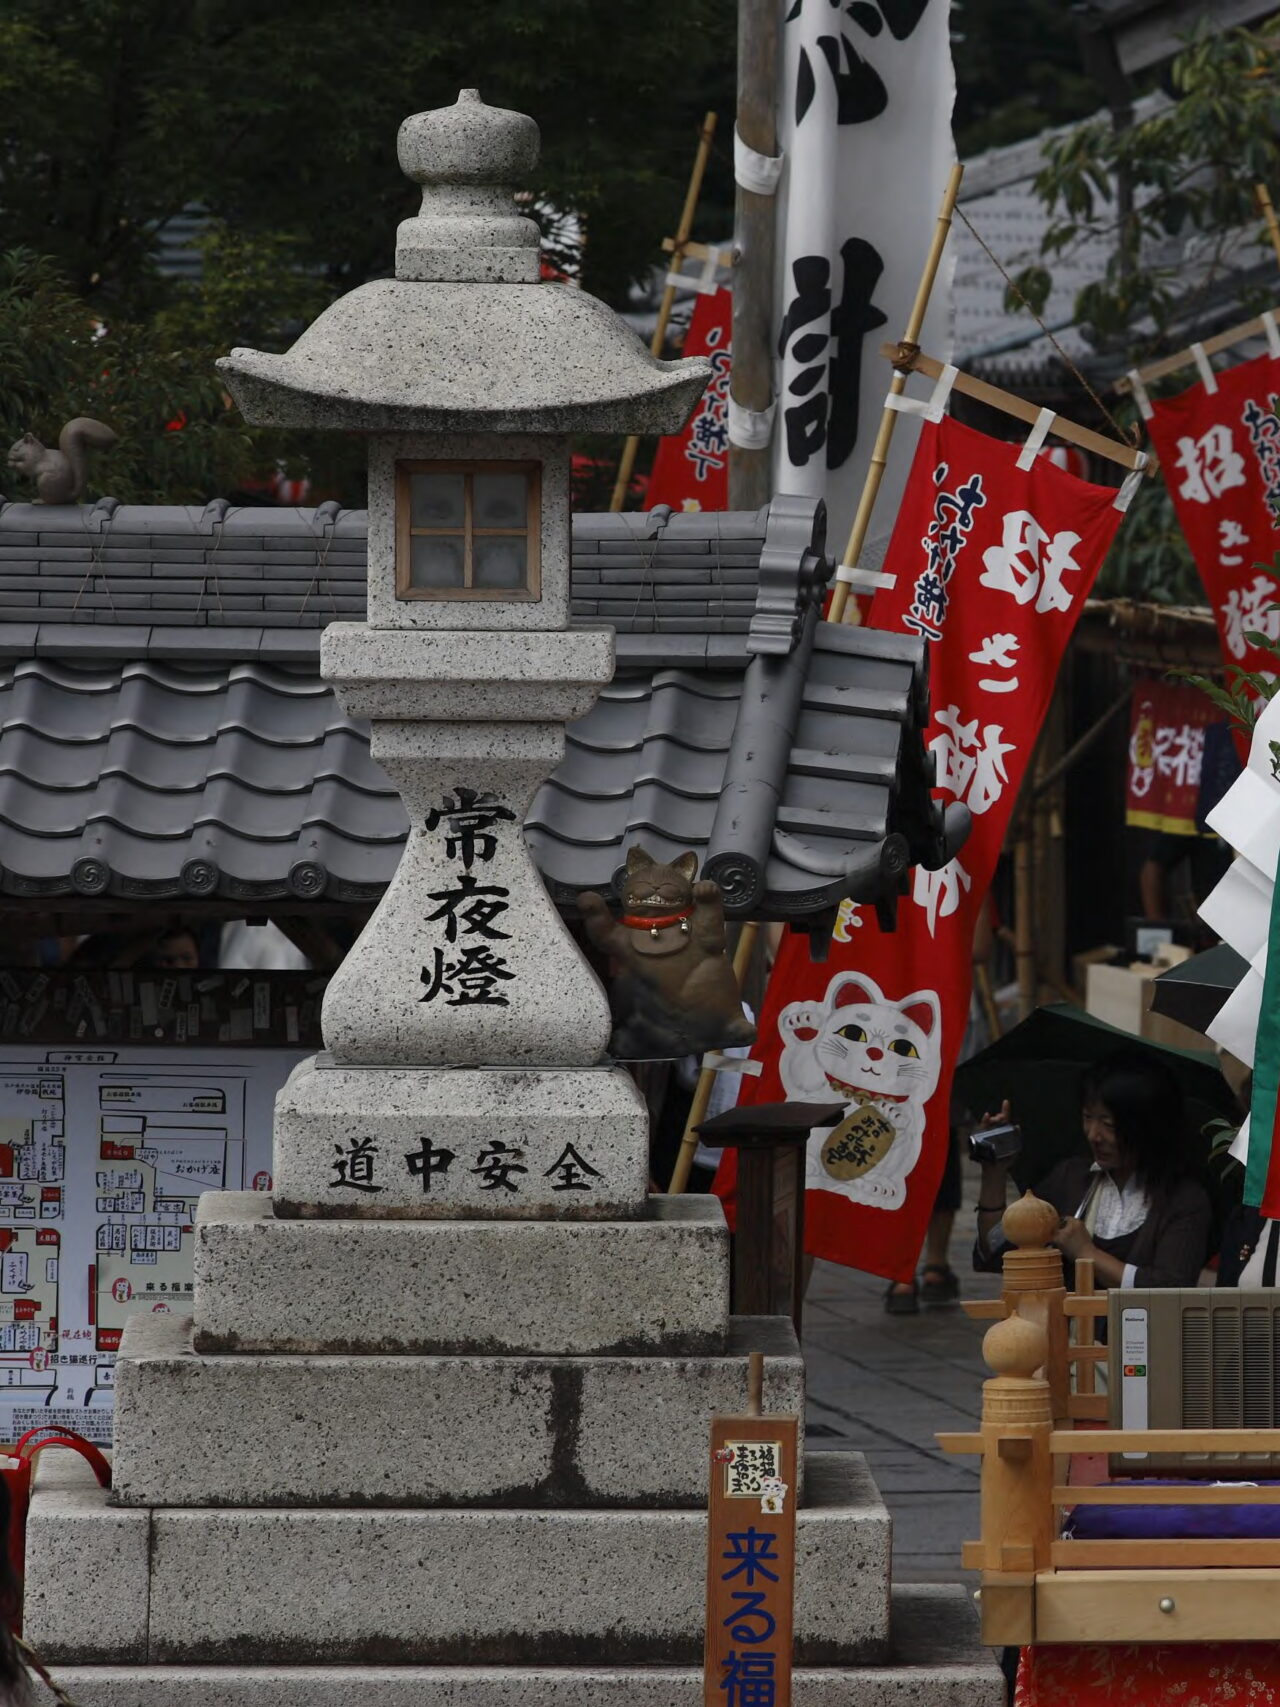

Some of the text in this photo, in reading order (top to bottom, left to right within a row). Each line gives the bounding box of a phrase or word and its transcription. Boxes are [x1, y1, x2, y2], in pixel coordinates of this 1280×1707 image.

[416, 786, 518, 1008] 常夜燈
[176, 1164, 221, 1175] おかげ座
[329, 1136, 602, 1194] 道中安全
[61, 1330, 92, 1340] 現在地
[50, 1354, 98, 1365] 招き猫巡行
[719, 1527, 780, 1707] 来る福
